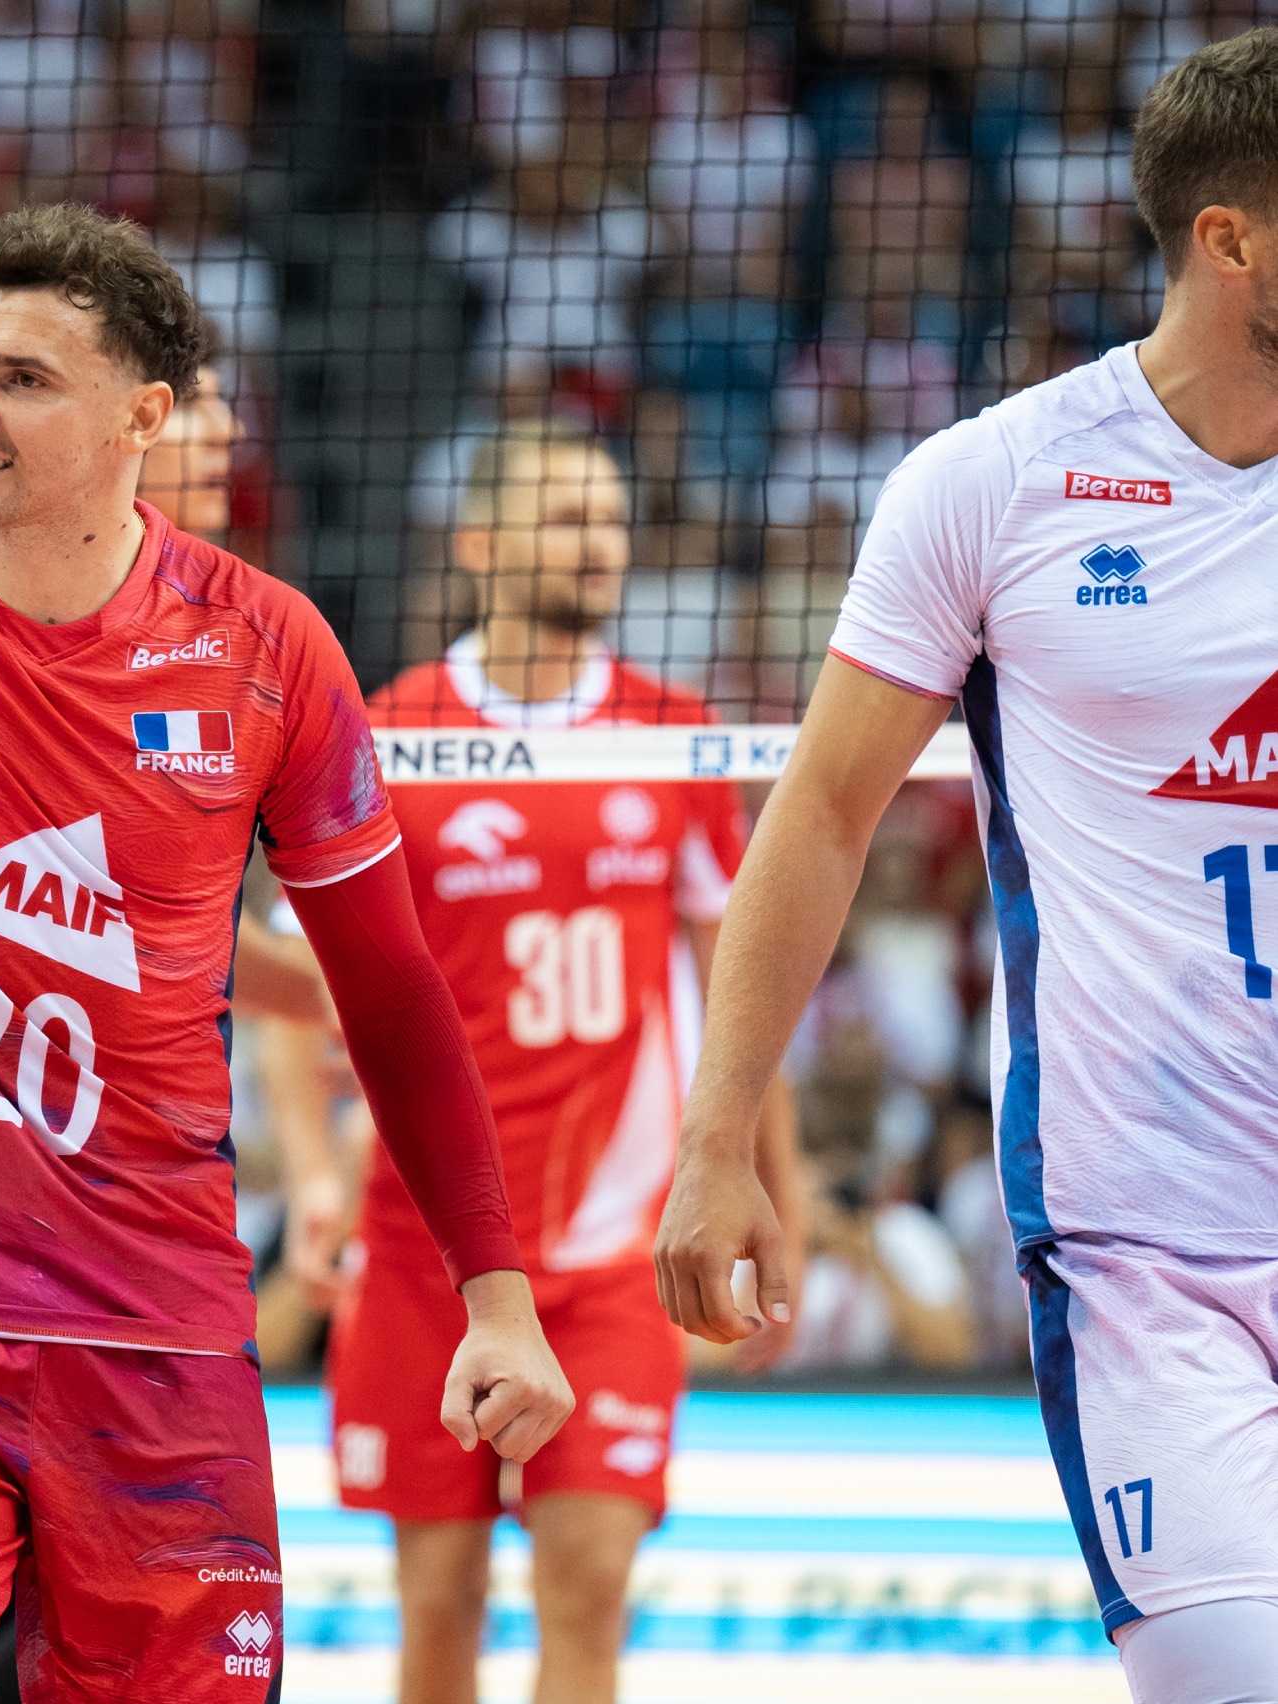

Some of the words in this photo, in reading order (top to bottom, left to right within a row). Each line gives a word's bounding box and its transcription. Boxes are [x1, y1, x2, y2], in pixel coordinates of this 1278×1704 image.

[1069, 474, 1166, 502] Betclic
[1076, 584, 1148, 606] errea
[131, 634, 224, 669] Betclic
[136, 752, 235, 774] FRANCE
[505, 905, 625, 1048] 30
[1104, 1477, 1153, 1559] 17
[198, 1567, 244, 1583] Crédit
[225, 1654, 271, 1678] errea
